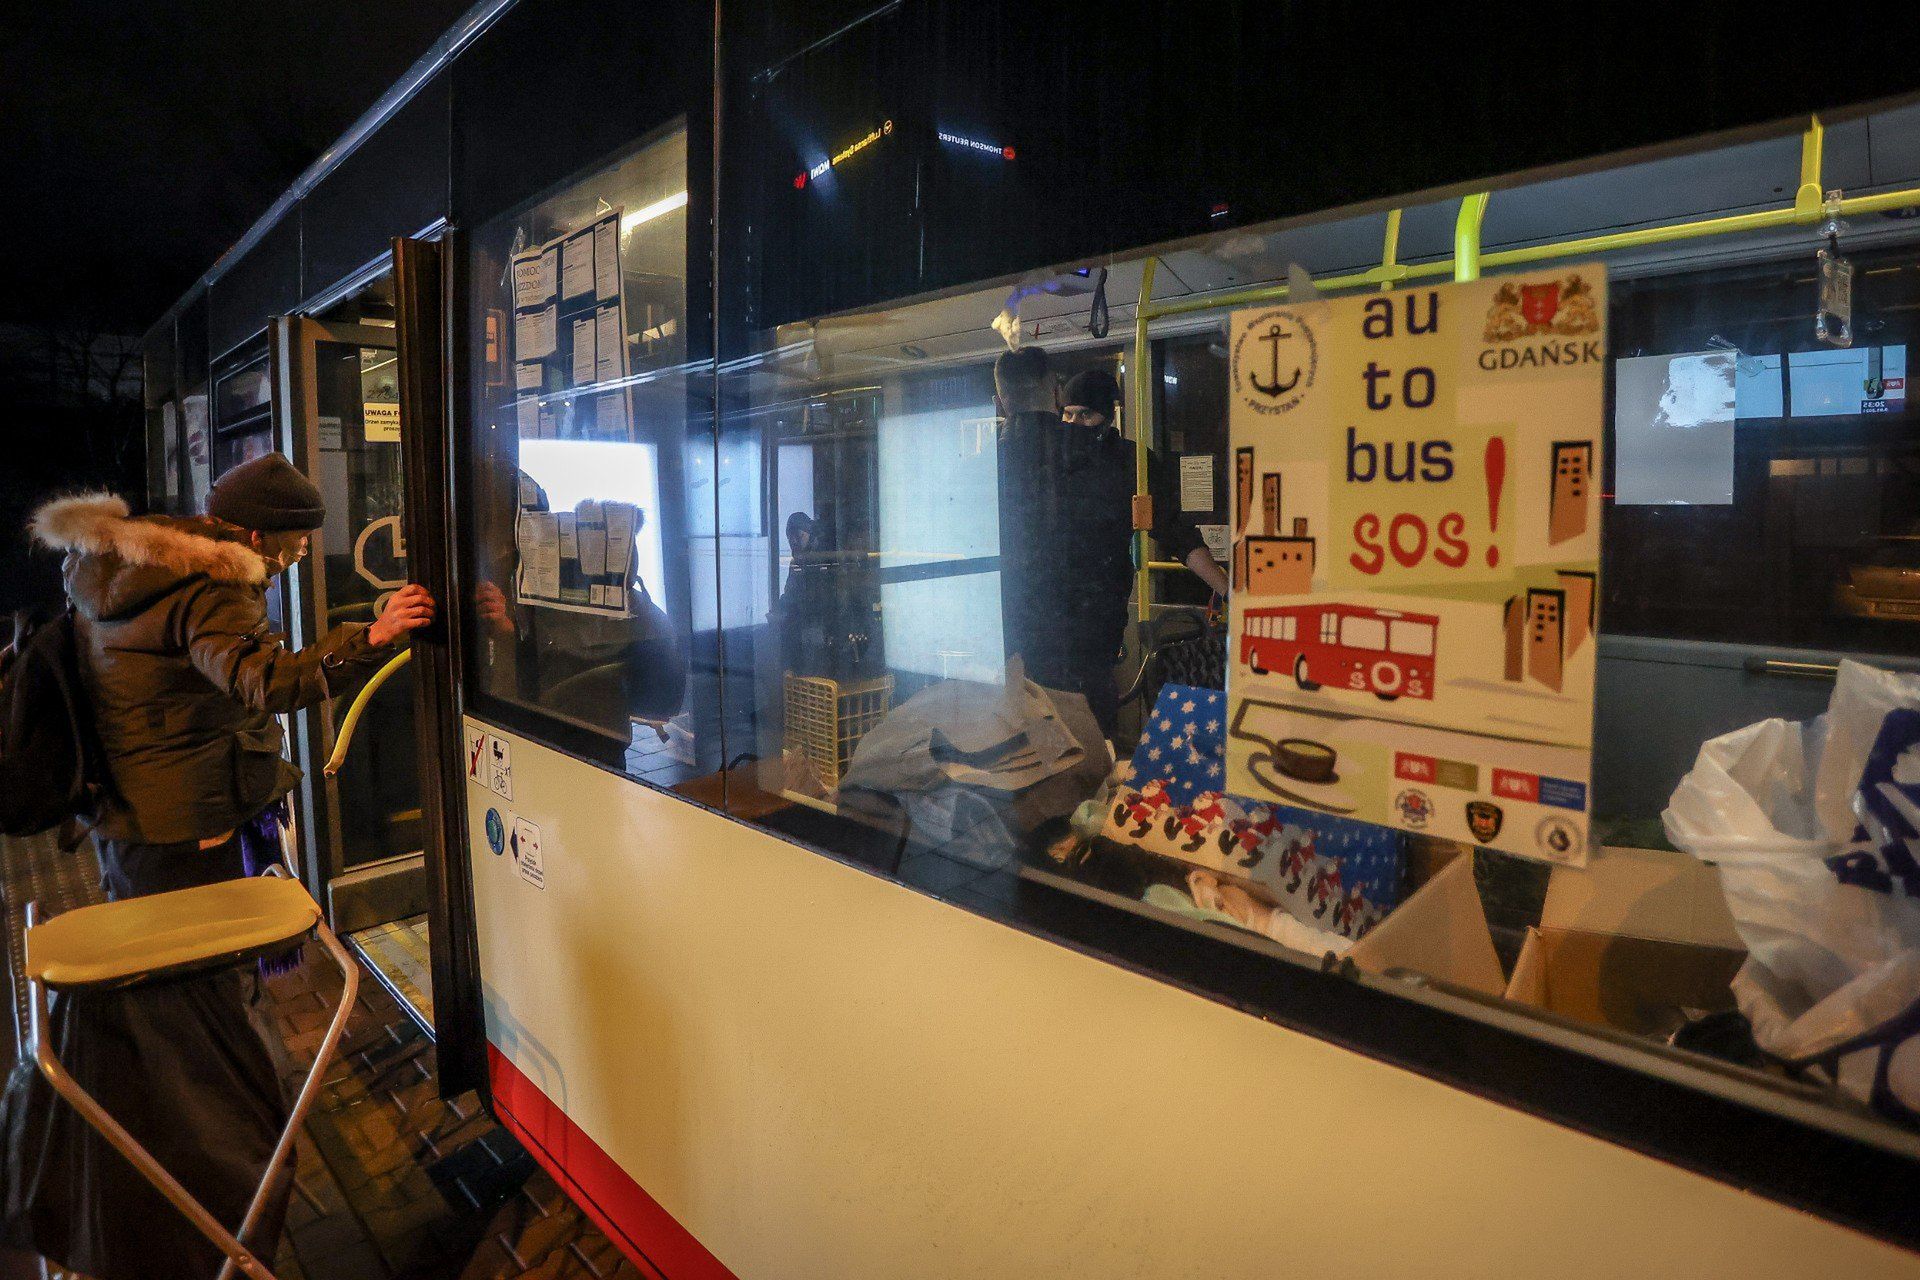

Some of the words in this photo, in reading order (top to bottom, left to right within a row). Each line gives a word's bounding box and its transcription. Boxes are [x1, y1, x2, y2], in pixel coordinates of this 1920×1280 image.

[1362, 291, 1439, 340] au
[1478, 339, 1601, 372] GDAŃSK
[1362, 361, 1438, 412] to
[1346, 426, 1456, 484] bus
